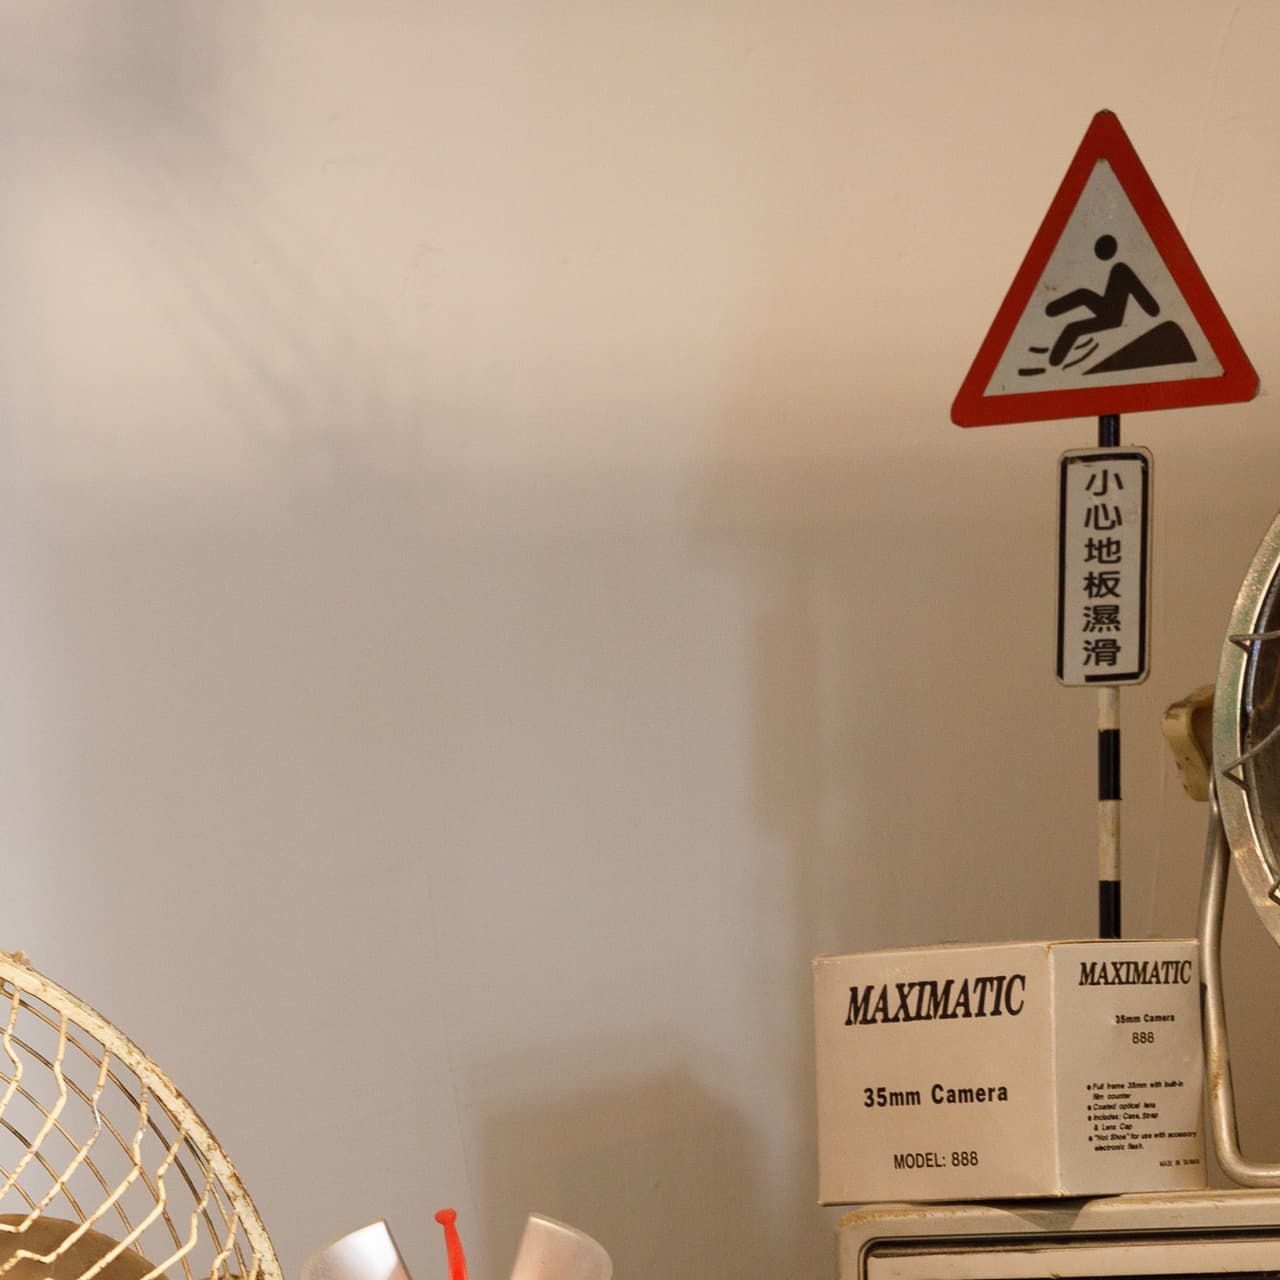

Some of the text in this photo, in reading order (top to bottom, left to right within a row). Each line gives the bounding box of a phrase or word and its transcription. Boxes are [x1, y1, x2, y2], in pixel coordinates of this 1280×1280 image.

[1082, 469, 1124, 667] 小心地板濕滑
[1078, 960, 1192, 986] MAXIMATIC
[845, 974, 1026, 1026] MAXIMATIC
[1115, 1013, 1175, 1024] 35mm Camera
[1132, 1031, 1155, 1044] 888
[863, 1084, 1008, 1108] 35mm Camera
[893, 1151, 979, 1170] MODEL: 888
